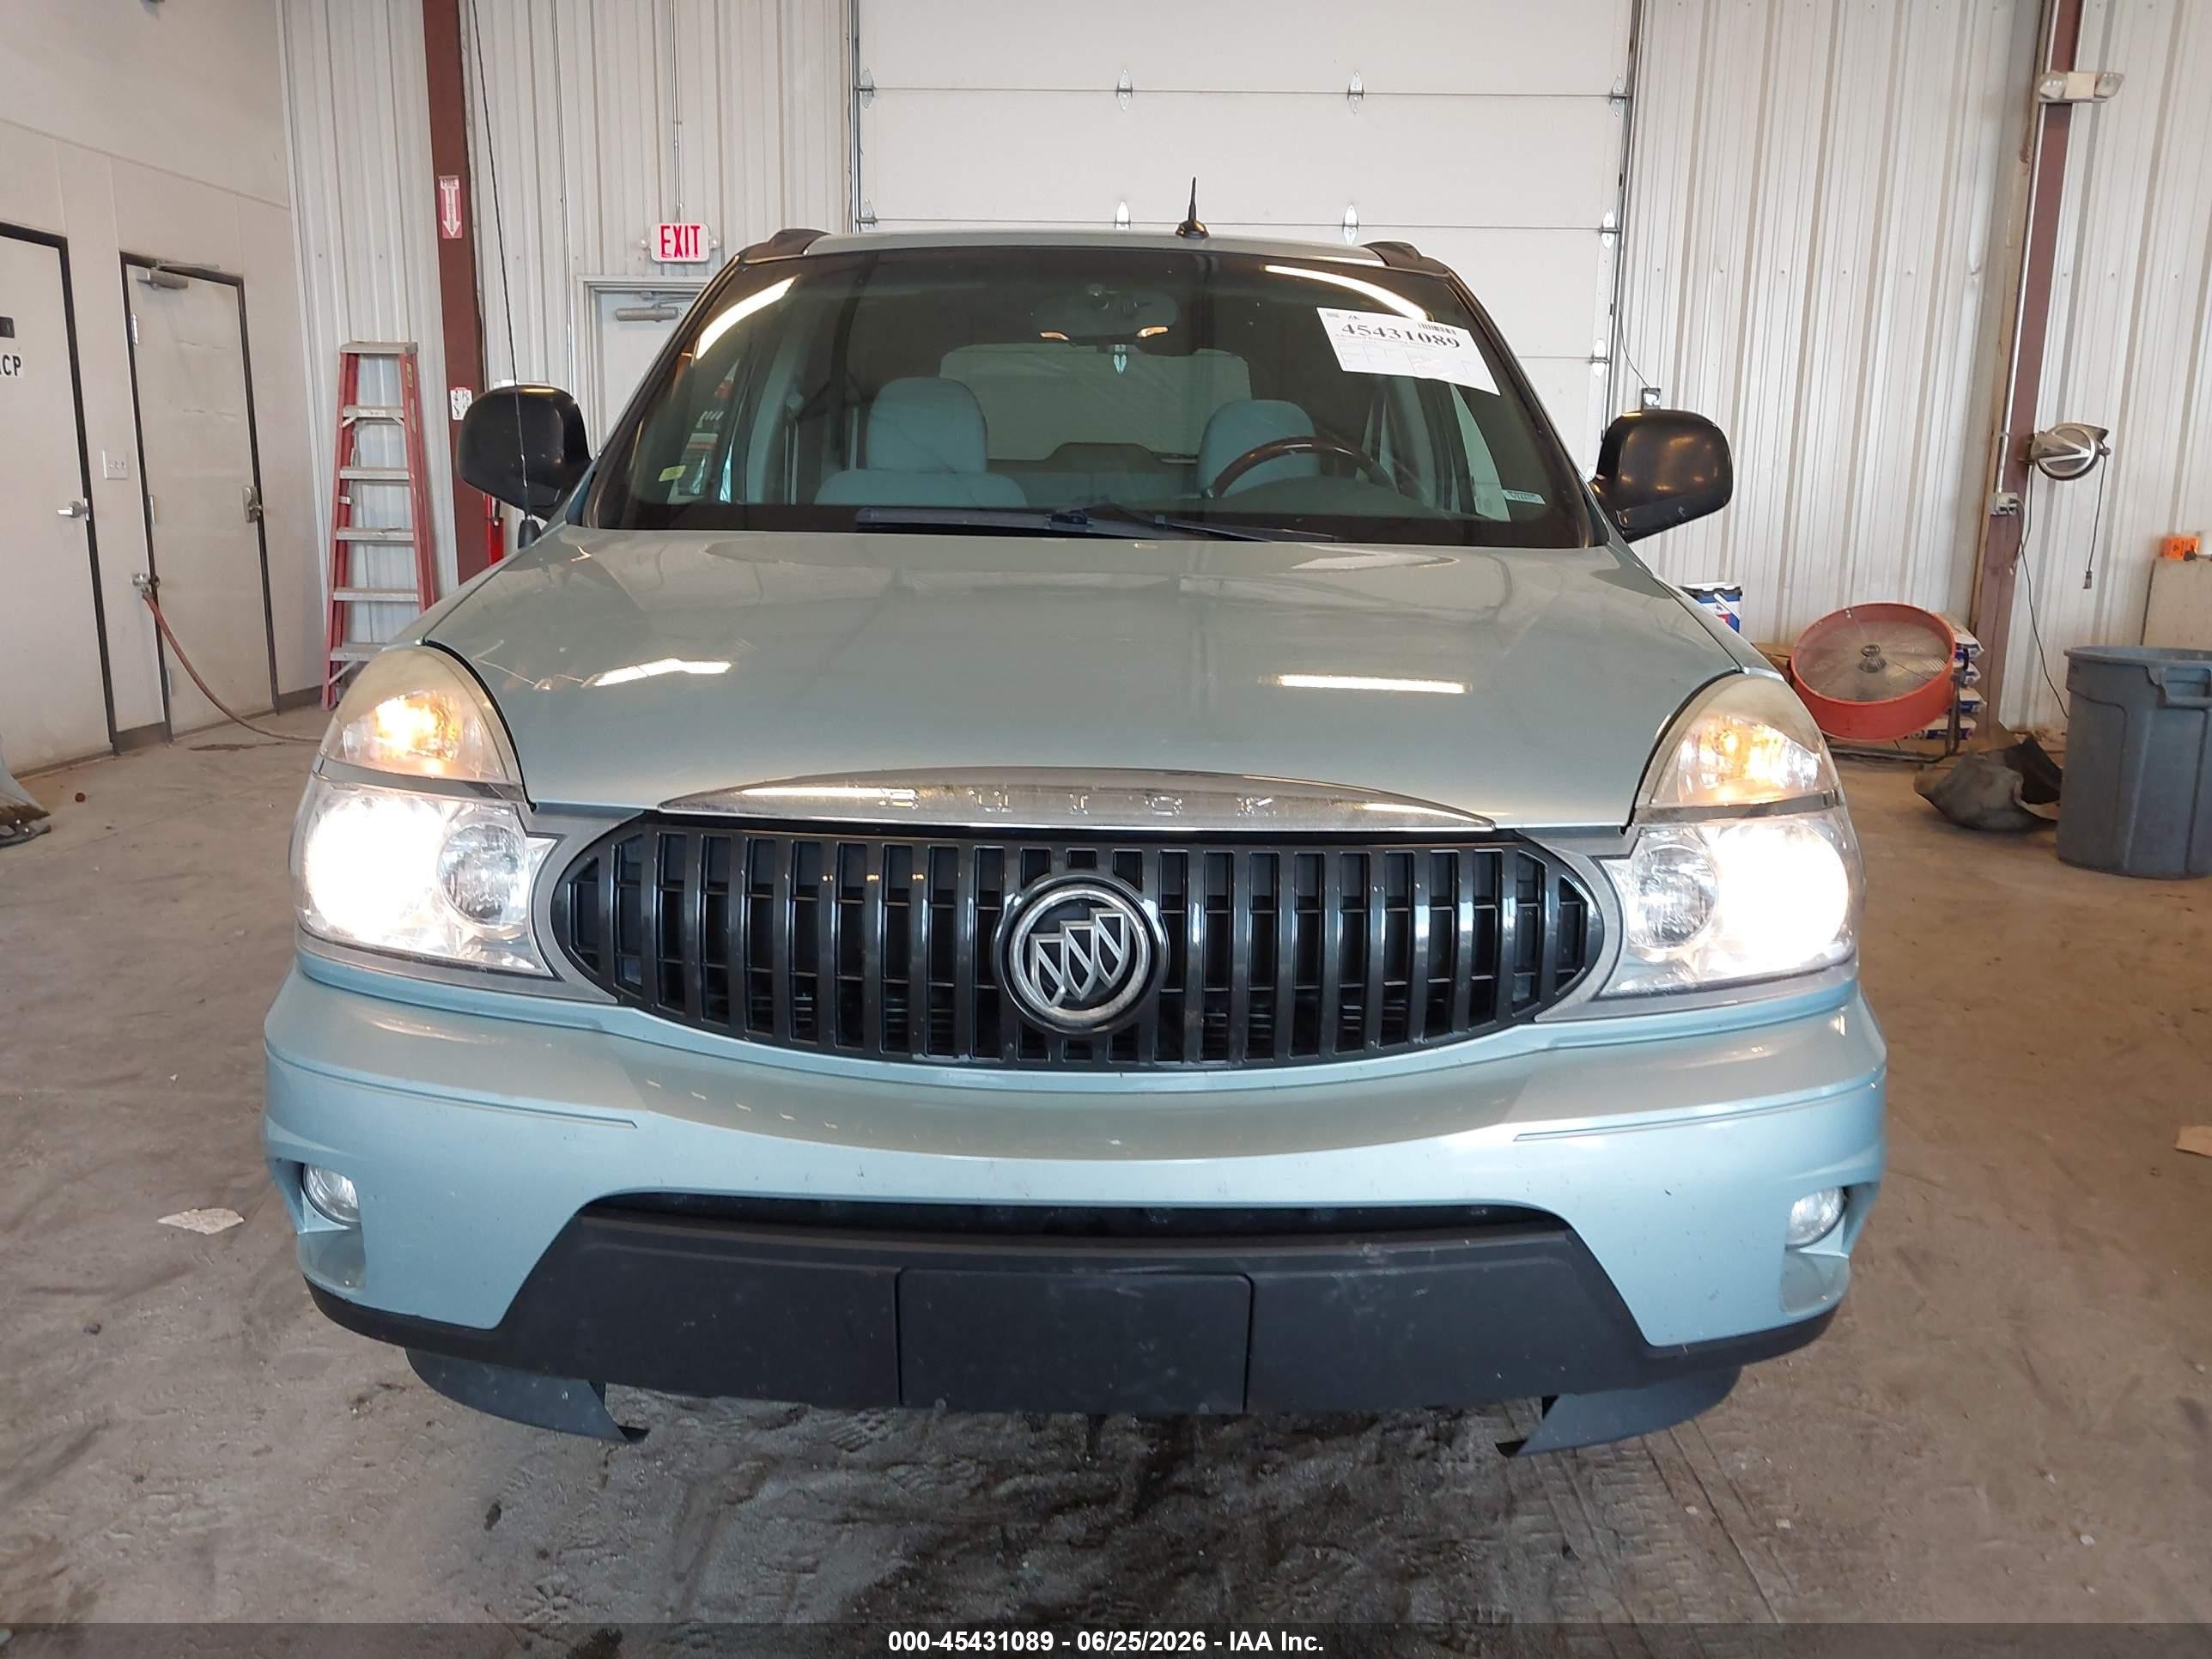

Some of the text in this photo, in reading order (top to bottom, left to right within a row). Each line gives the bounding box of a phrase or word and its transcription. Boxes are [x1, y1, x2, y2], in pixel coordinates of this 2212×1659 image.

[660, 225, 700, 258] EXIT
[1341, 323, 1461, 349] 45431089
[0, 354, 21, 377] CP
[879, 787, 1278, 817] BUICK
